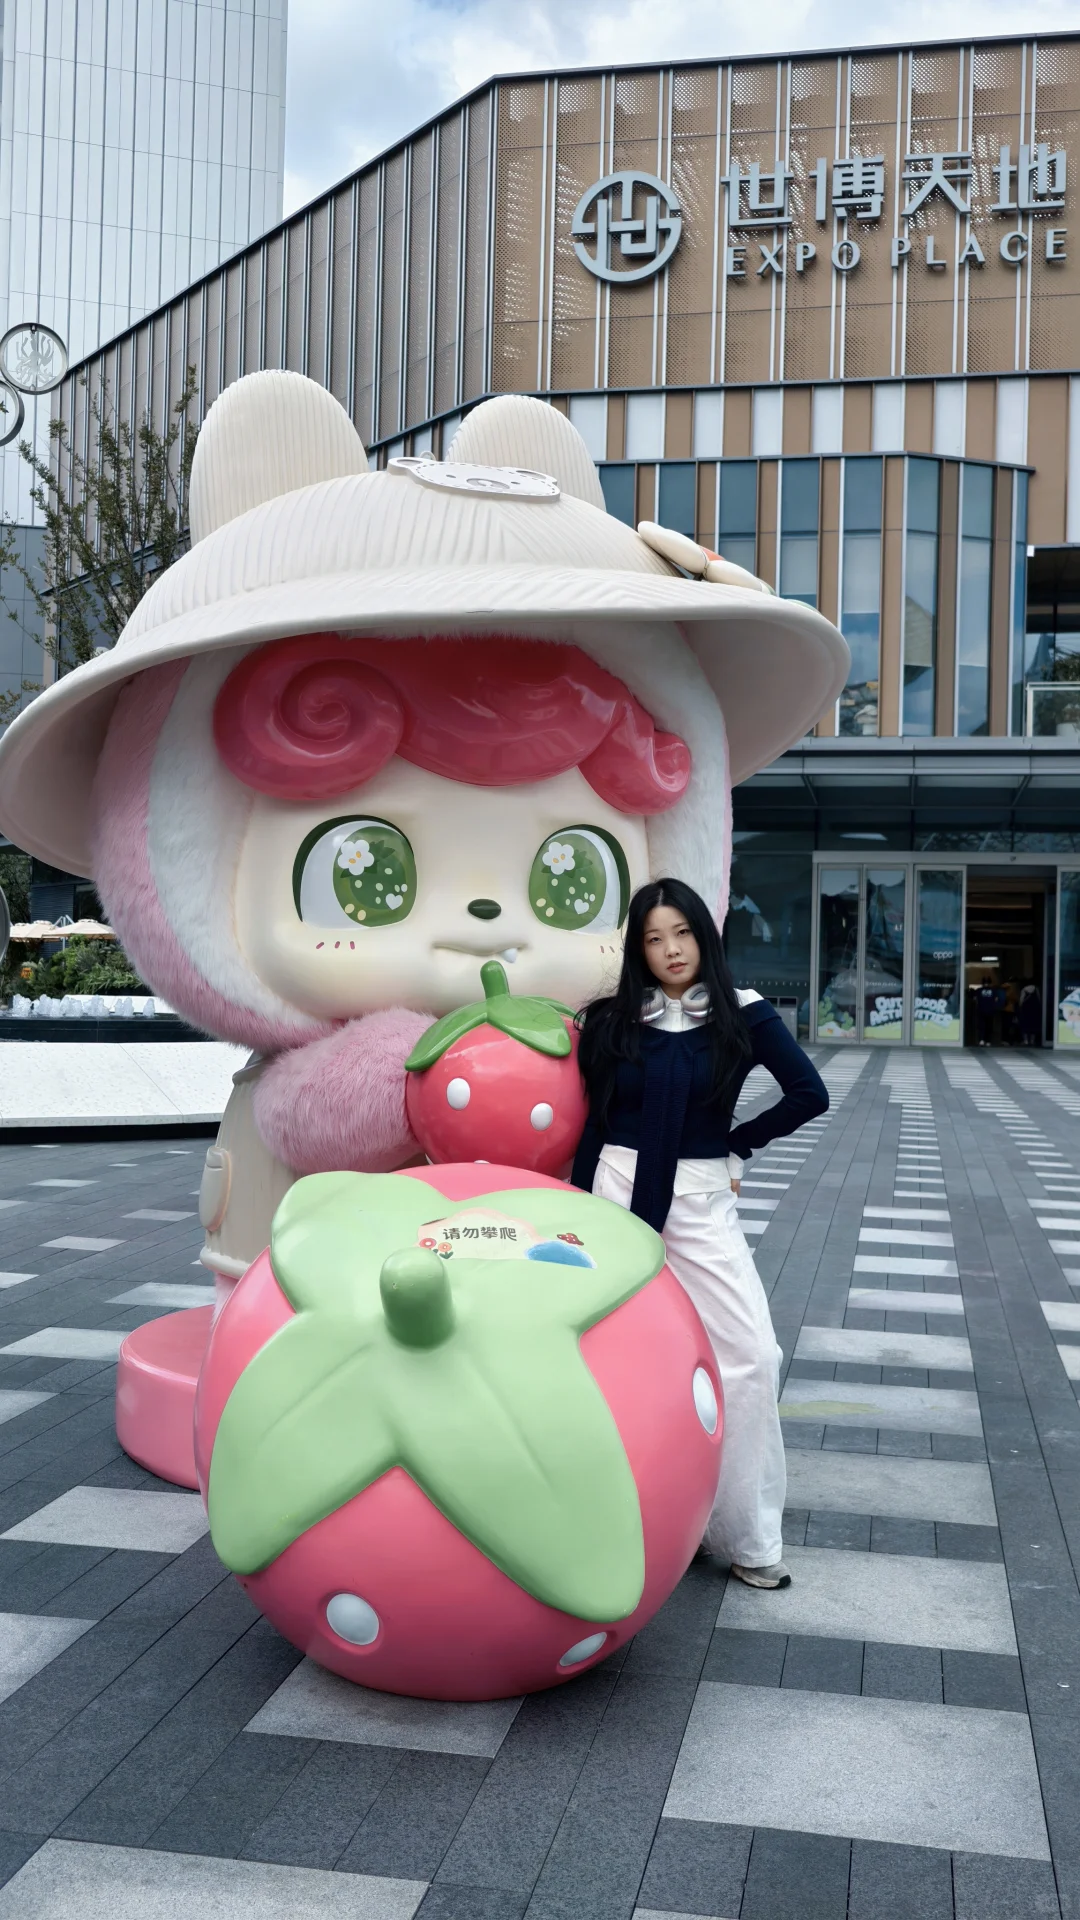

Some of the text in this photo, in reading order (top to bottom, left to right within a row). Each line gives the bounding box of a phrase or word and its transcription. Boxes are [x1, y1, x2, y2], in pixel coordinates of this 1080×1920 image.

[721, 143, 1067, 227] 世博天地
[727, 228, 1067, 277] EXPO PLACE
[442, 1226, 518, 1241] 请勿攀爬
